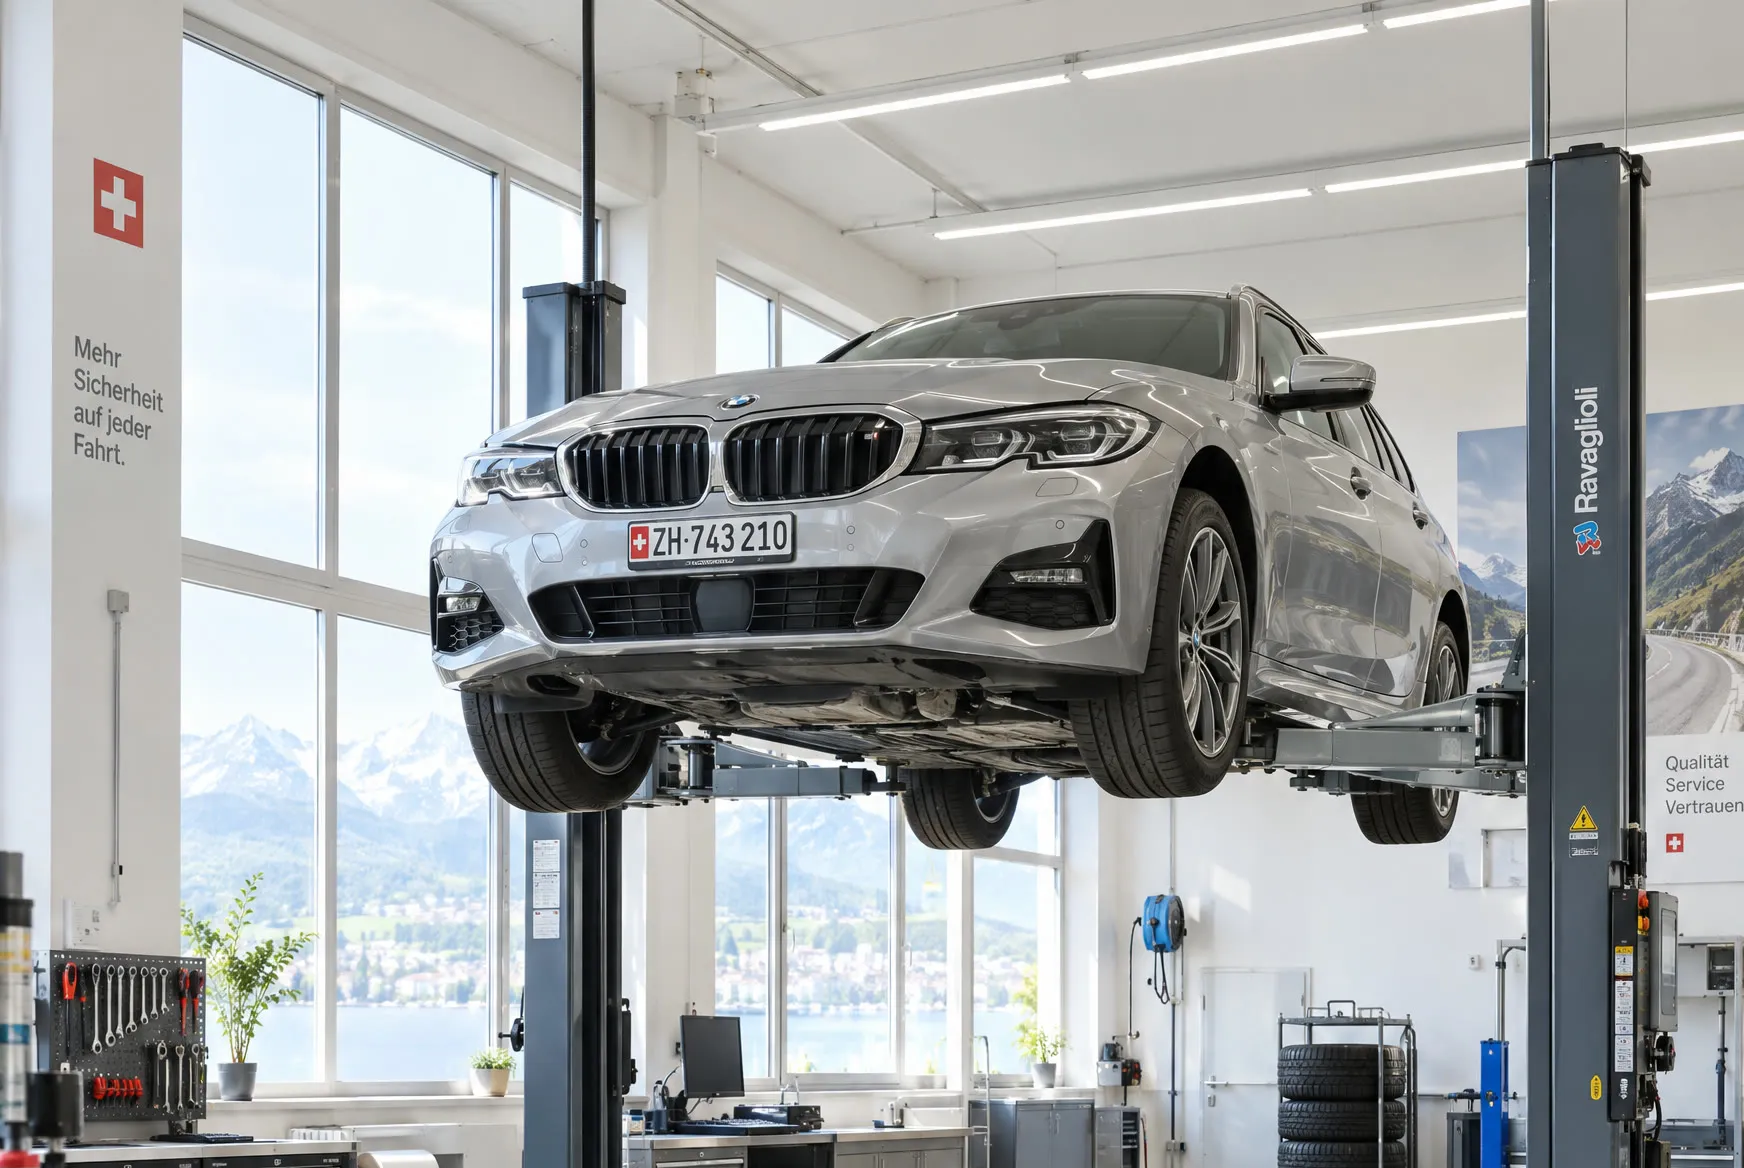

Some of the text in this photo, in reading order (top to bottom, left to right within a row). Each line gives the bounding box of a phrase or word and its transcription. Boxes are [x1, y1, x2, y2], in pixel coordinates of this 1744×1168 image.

[74, 335, 122, 368] Mehr
[74, 368, 164, 413] Sicherheit
[74, 406, 152, 440] auf jeder
[74, 432, 125, 466] Fahrt.
[1574, 386, 1604, 514] Ravaglioli
[1666, 754, 1730, 772] Qualität
[1666, 777, 1725, 792] Service
[1666, 799, 1744, 815] Vertrauen
